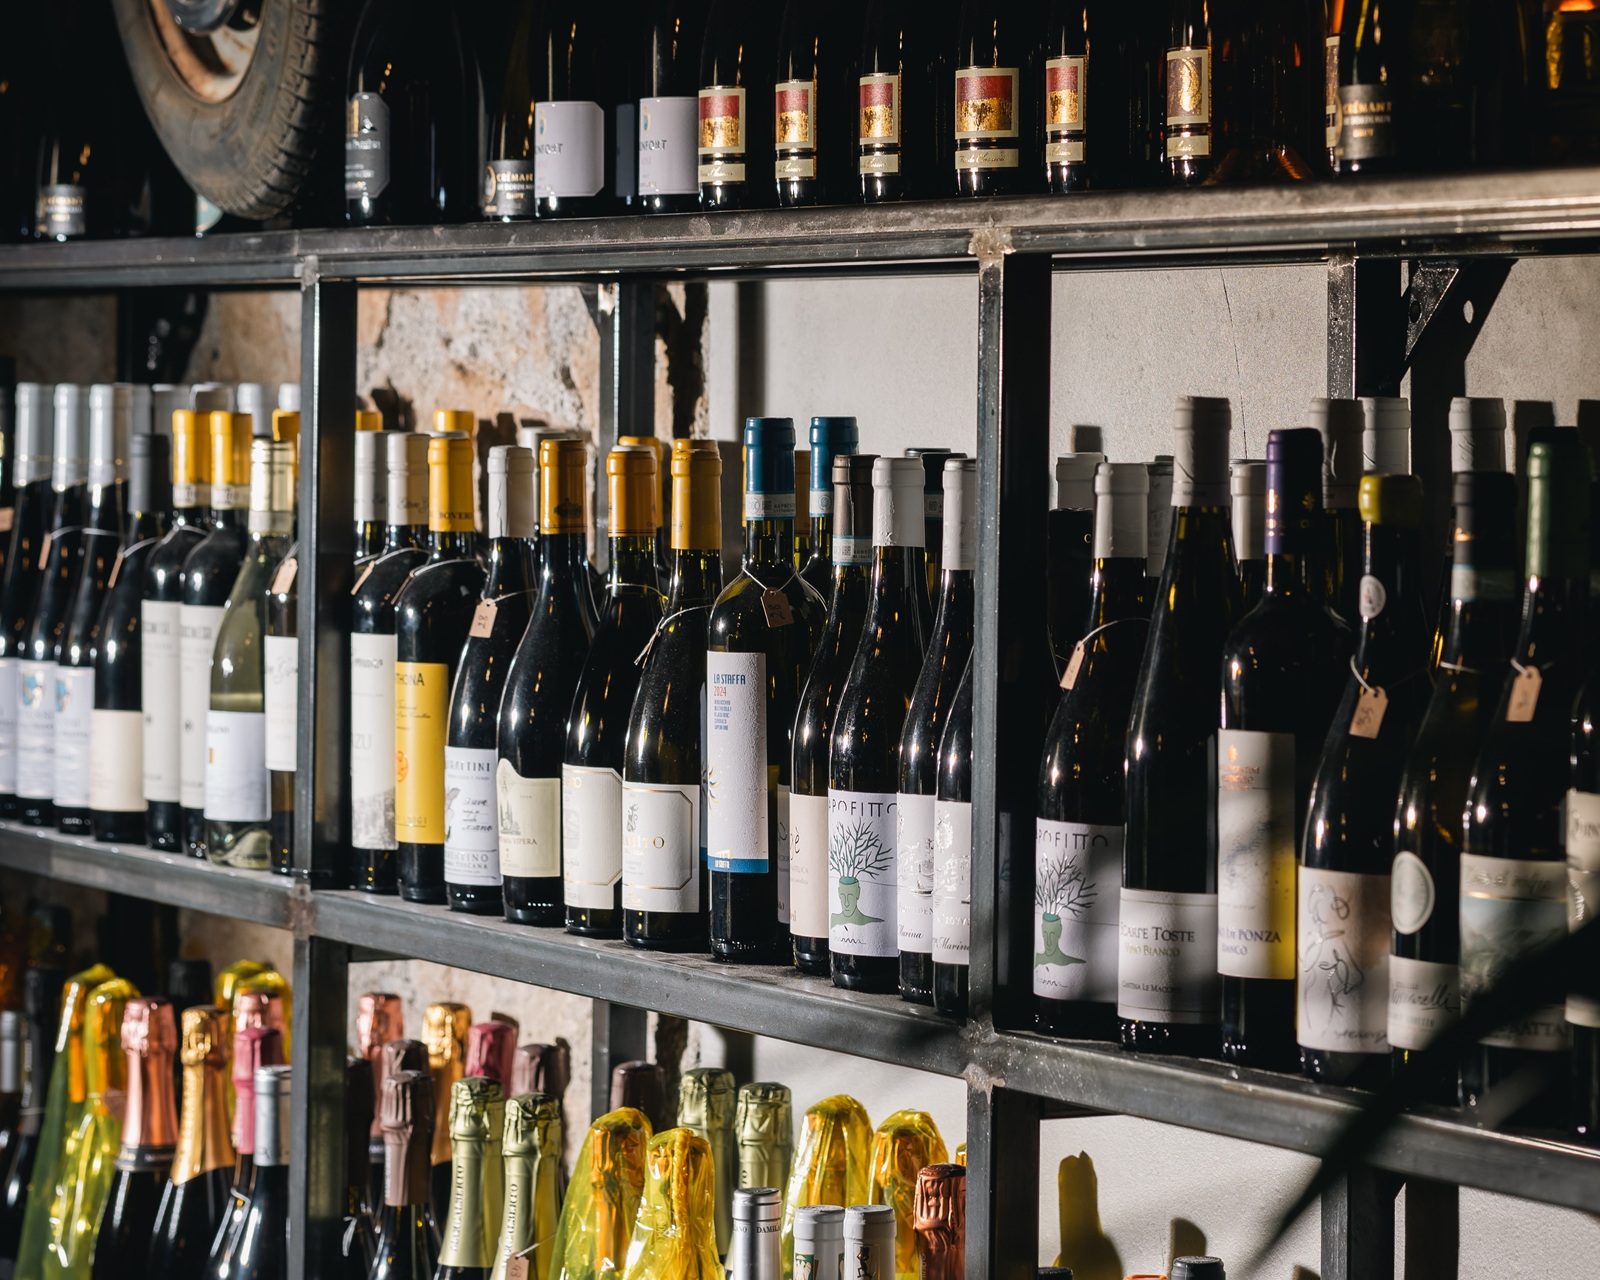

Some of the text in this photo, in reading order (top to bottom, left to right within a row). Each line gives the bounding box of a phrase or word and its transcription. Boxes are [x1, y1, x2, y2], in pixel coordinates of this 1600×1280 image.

[714, 673, 746, 684] LA STAFFA
[829, 799, 897, 817] POFITTO
[1036, 829, 1108, 849] POFITTO
[1152, 926, 1195, 942] TOSTE
[1239, 928, 1281, 943] PONZA
